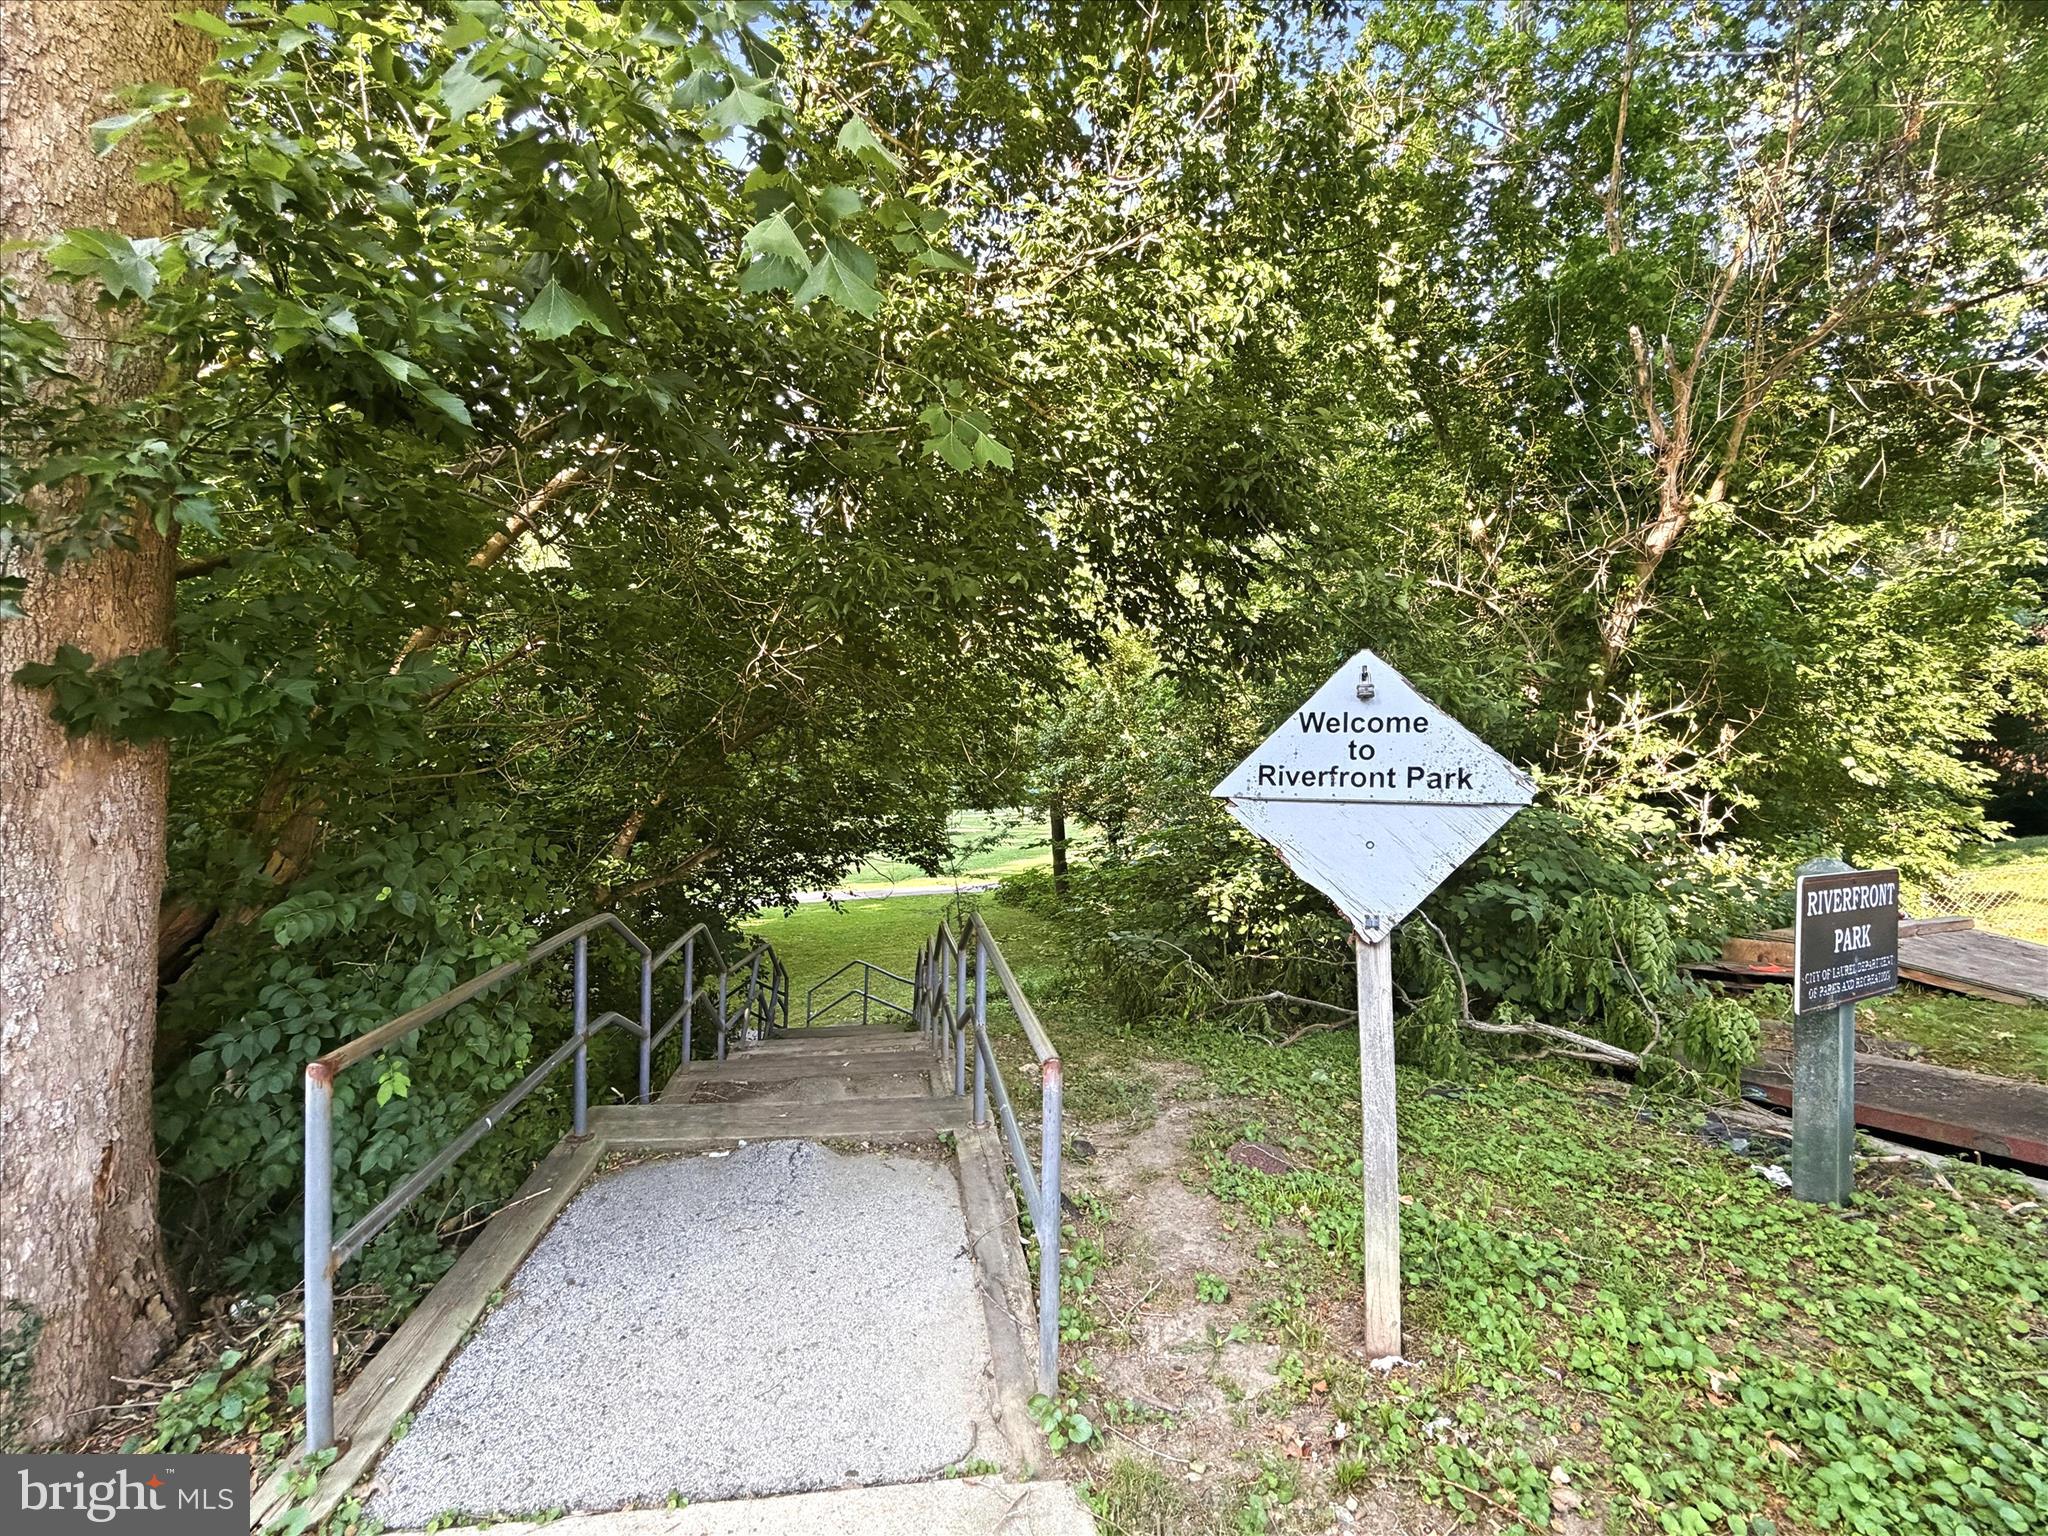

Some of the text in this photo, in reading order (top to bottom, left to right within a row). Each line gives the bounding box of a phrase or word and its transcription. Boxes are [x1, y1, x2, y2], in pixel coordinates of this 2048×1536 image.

[1298, 711, 1429, 734] Welcome
[1348, 740, 1375, 761] to
[1258, 764, 1474, 790] Riverfront Park
[1806, 882, 1896, 917] RIVERFRONT
[1833, 923, 1872, 953] PARK
[1804, 970, 1821, 984] CITY
[1821, 968, 1832, 981] OF
[1808, 987, 1818, 1000] OF
[1819, 982, 1841, 997] PARKS
[1841, 979, 1855, 992] AND
